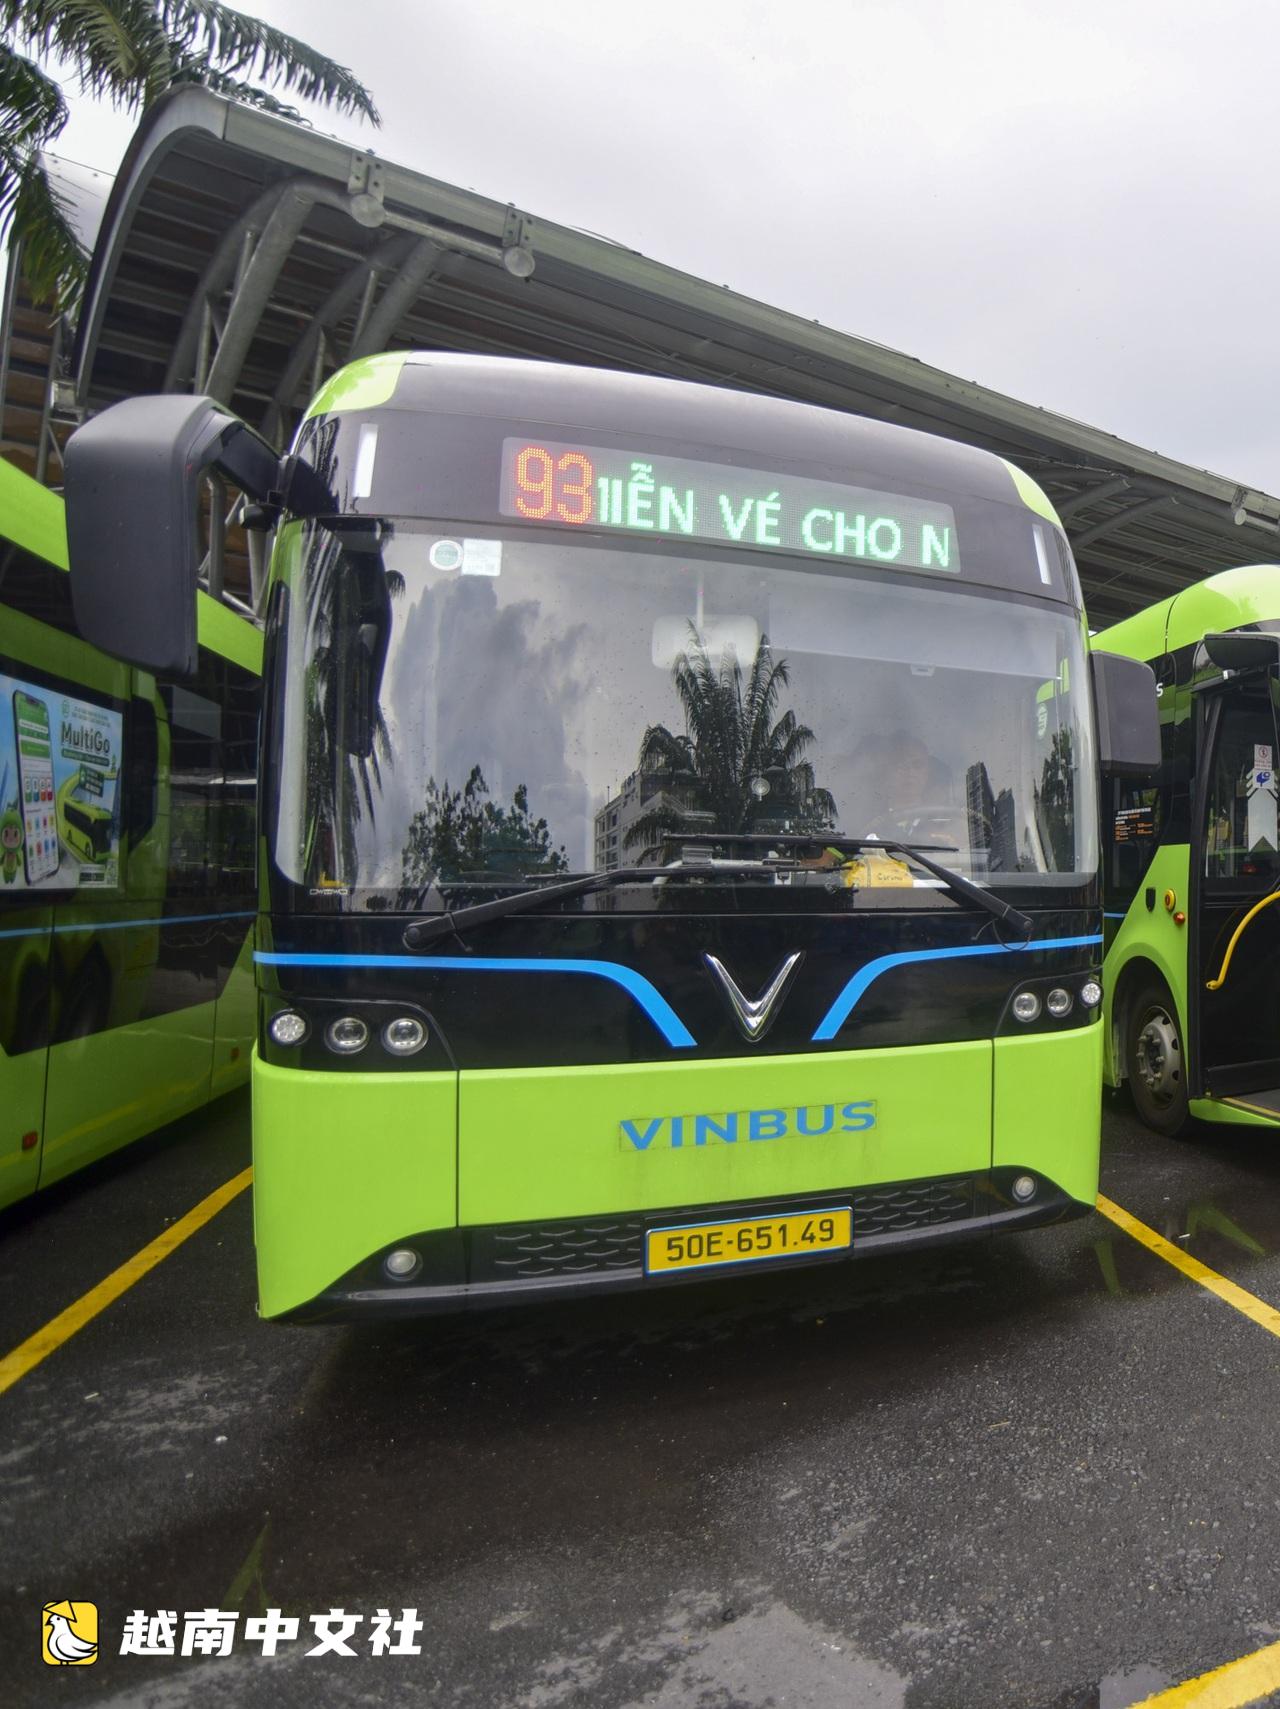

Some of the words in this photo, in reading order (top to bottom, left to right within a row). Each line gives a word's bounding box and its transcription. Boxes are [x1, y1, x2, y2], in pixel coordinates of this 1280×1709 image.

[516, 447, 593, 524] 93
[598, 462, 694, 533] IỄN
[718, 491, 781, 545] VÉ
[802, 508, 901, 560] CHO
[922, 525, 950, 567] N
[61, 721, 110, 753] MultiGo
[620, 1100, 877, 1150] VINBUS
[667, 1218, 834, 1262] 50E-651.49
